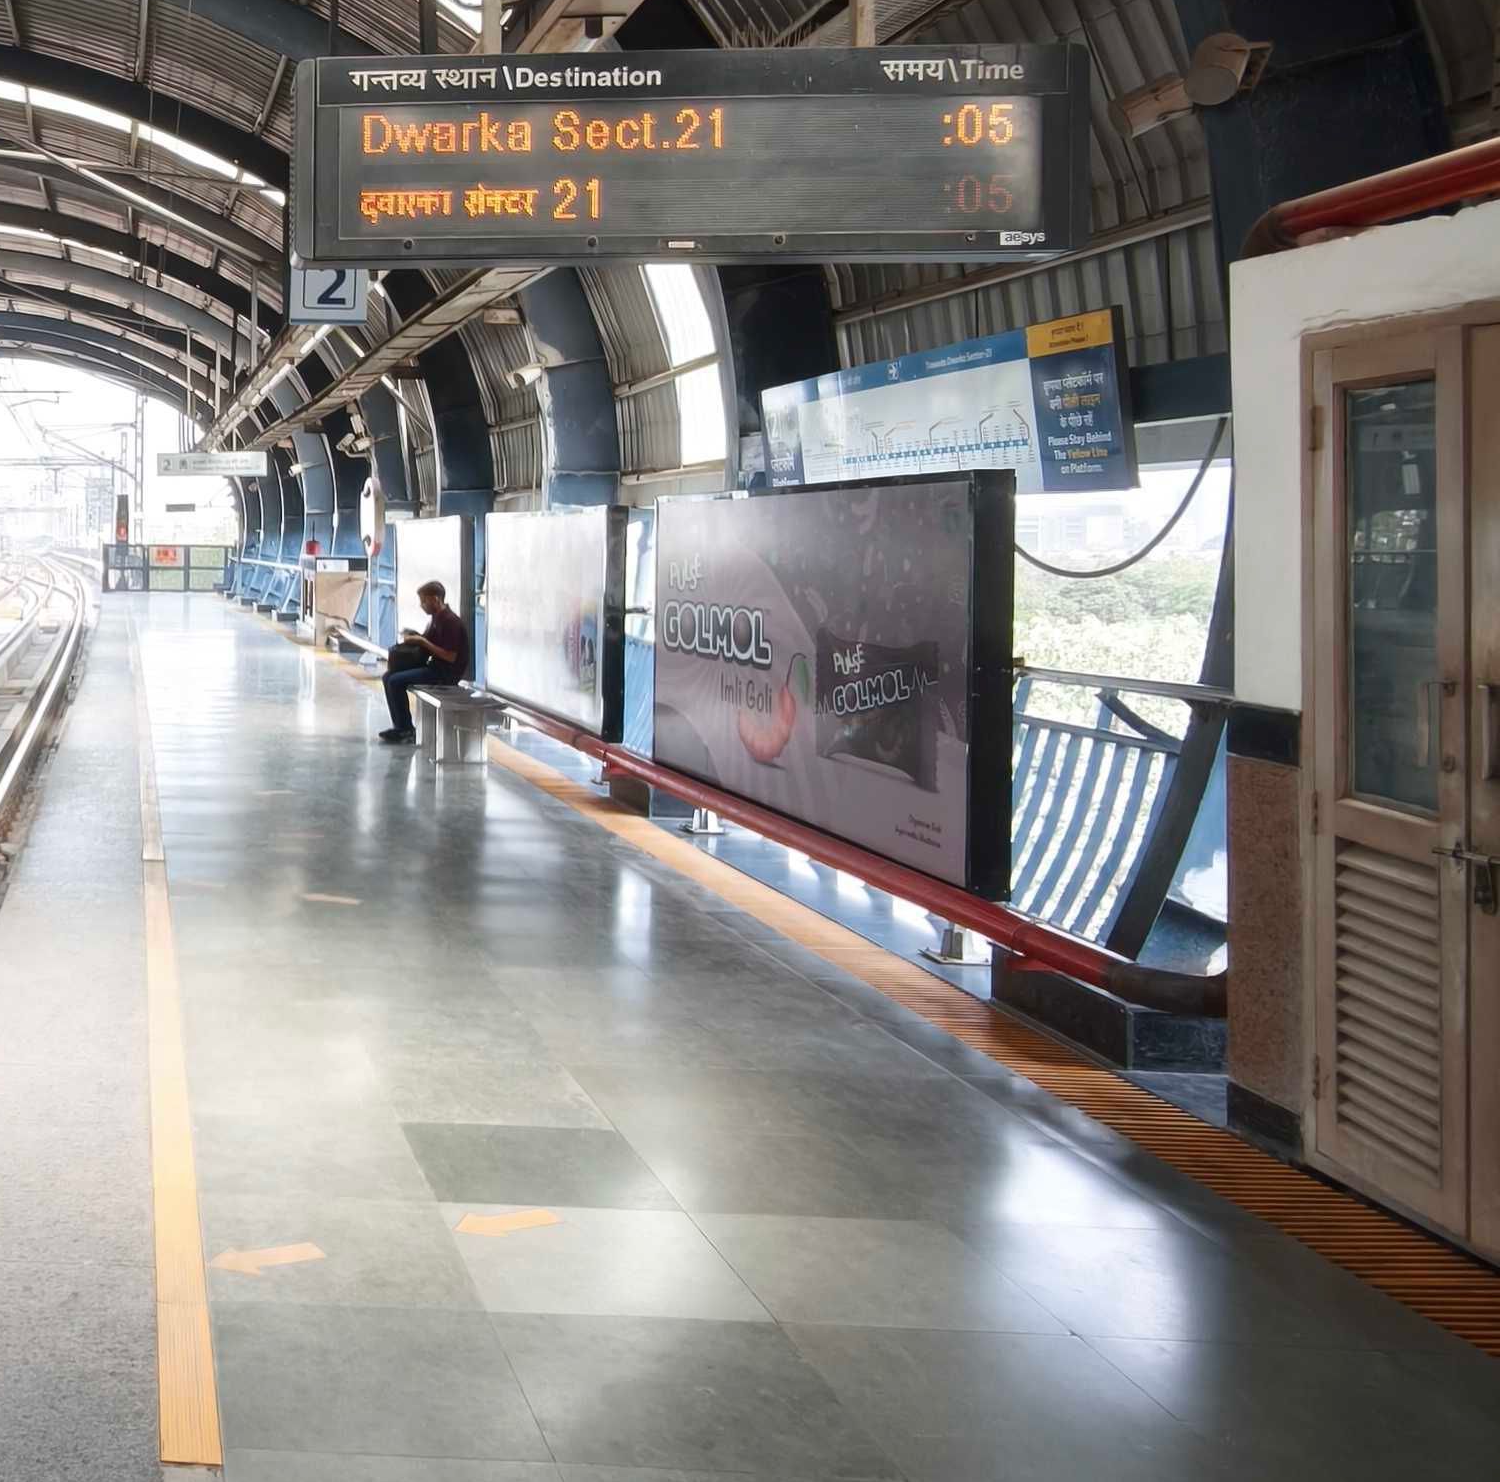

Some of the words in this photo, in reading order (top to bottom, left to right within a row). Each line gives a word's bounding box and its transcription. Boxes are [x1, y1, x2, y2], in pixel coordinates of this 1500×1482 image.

[350, 69, 427, 92] गन्तव्य
[433, 67, 497, 90] स्थान
[361, 112, 534, 155] Dwarka
[552, 107, 725, 152] Sect.21
[942, 104, 1014, 147] :05
[553, 178, 599, 219] 21
[943, 173, 1014, 214] :05
[1002, 231, 1046, 245] aesys
[317, 269, 346, 305] 2
[1048, 435, 1069, 446] Please
[1069, 433, 1085, 447] Stay
[1086, 431, 1112, 444] Behind
[1054, 449, 1067, 460] The
[1067, 447, 1092, 459] Yellow
[1092, 447, 1108, 458] Line
[163, 459, 172, 471] 2
[663, 601, 772, 668] GOLMOL
[719, 672, 743, 709] Imli
[745, 679, 773, 715] Goli
[832, 668, 911, 717] GOLMOL
